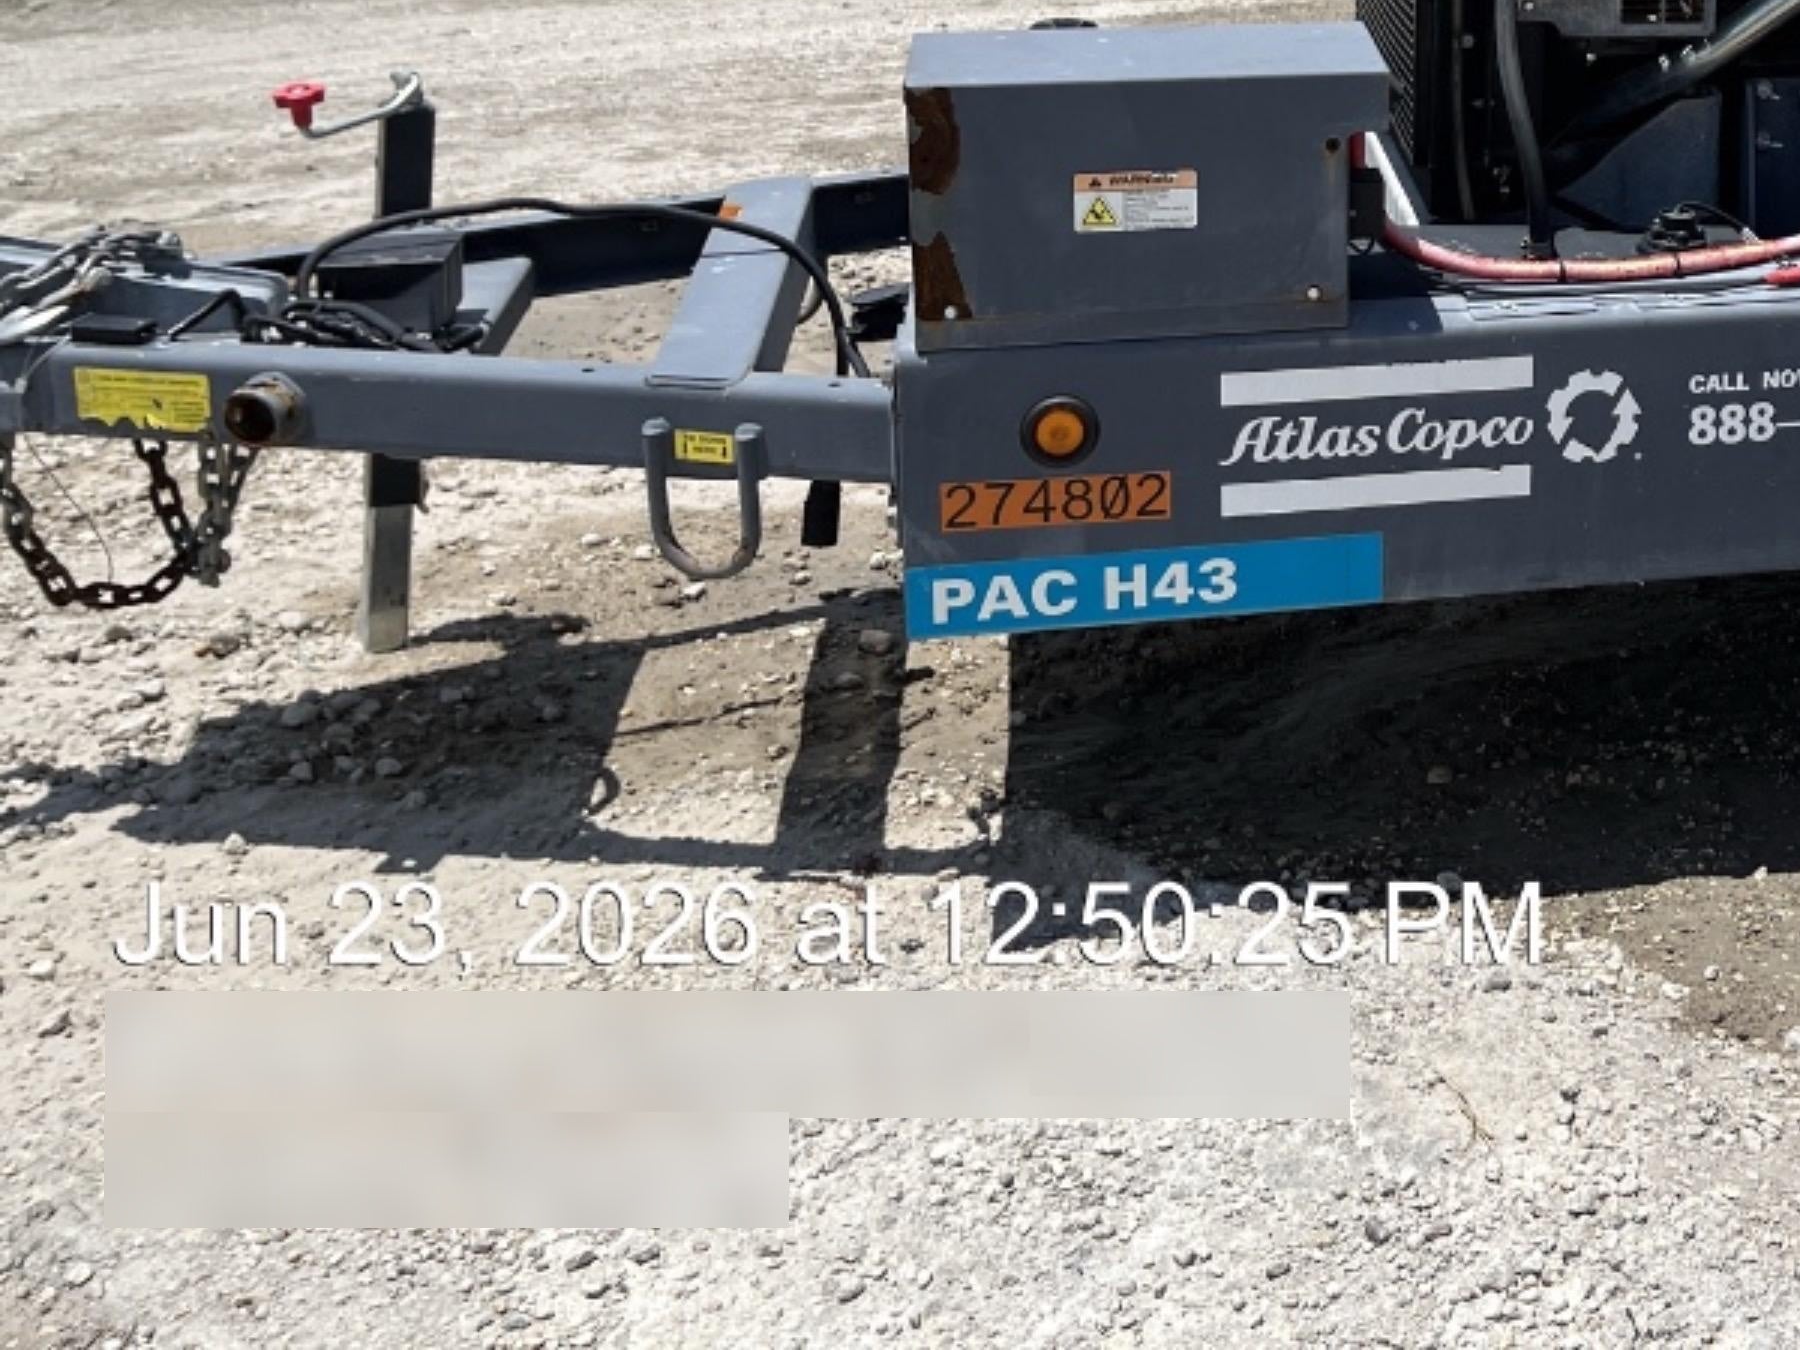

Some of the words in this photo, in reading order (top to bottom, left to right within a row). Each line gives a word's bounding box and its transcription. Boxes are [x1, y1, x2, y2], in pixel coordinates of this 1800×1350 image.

[1688, 371, 1750, 394] CALL
[1217, 415, 1381, 466] Atlas
[1386, 407, 1535, 461] Copco
[943, 472, 1169, 530] 274802
[931, 569, 1079, 625] PAC
[1103, 557, 1239, 611] H43
